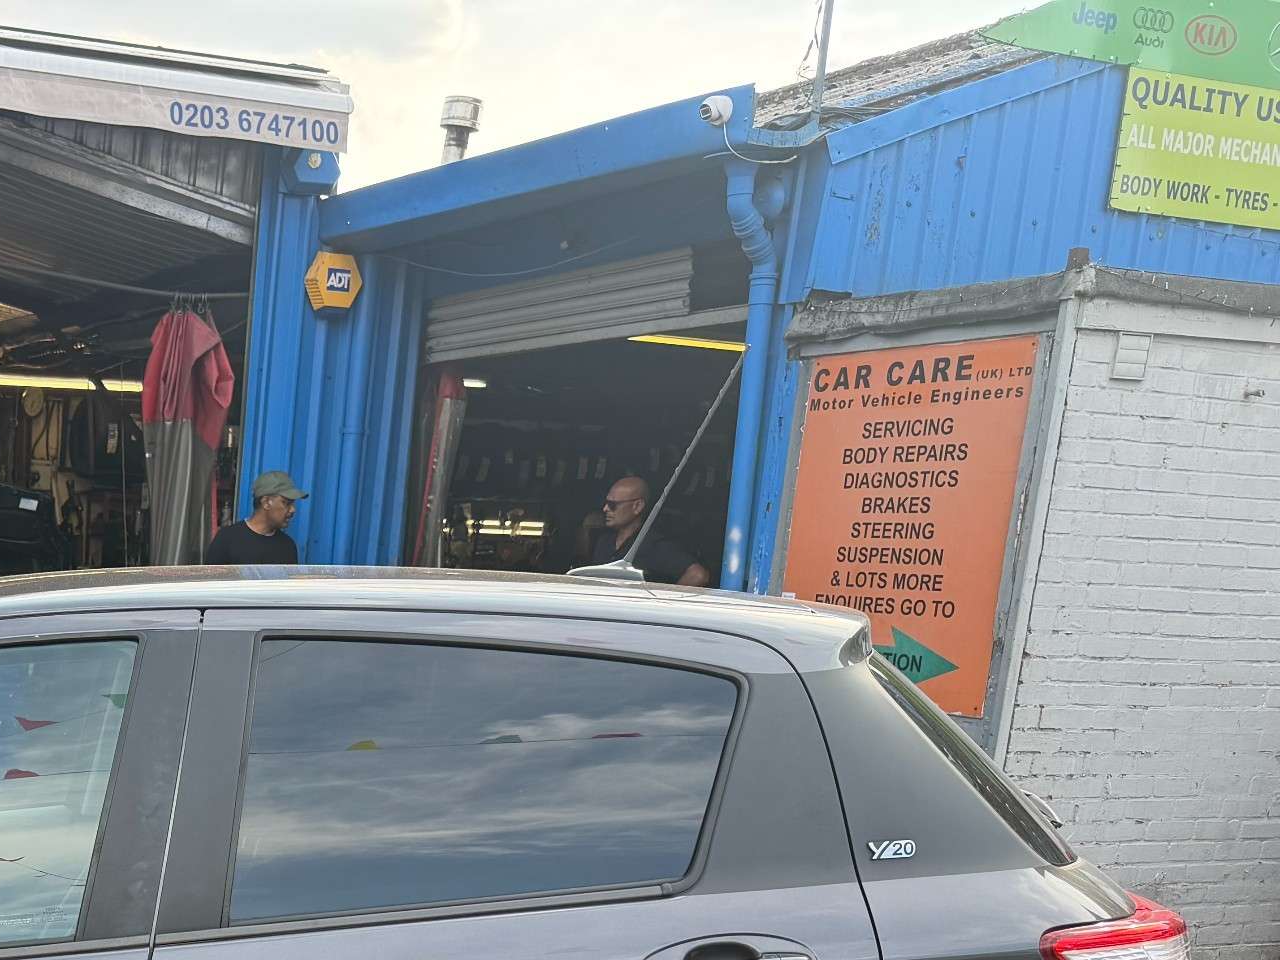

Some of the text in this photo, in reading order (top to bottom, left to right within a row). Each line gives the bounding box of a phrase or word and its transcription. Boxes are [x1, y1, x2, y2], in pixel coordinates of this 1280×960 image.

[1072, 2, 1118, 34] Jeep
[1134, 33, 1164, 48] Audi
[1193, 22, 1228, 48] KIA
[1132, 76, 1250, 117] QUALITY
[170, 101, 339, 144] 0203 6747100
[1127, 124, 1155, 149] ALL
[1161, 127, 1215, 158] MAJOR
[1120, 174, 1163, 198] BODY
[1166, 180, 1211, 204] WORK
[1225, 187, 1270, 212] TYRES
[327, 272, 351, 289] ADT
[814, 354, 1033, 393] CAR CARE (UK) LTD
[809, 386, 1024, 412] Motor Vehicle Engineers
[862, 417, 954, 439] SERVICING
[842, 443, 969, 465] BODY REPAIRS
[843, 469, 959, 489] DIAGNOSTICS
[861, 496, 931, 514] BRAKES
[850, 522, 935, 540] STEERING
[836, 546, 944, 566] SUSPENSION
[830, 570, 944, 592] & LOTS MORE
[900, 599, 926, 616] GO
[932, 600, 955, 619] TO
